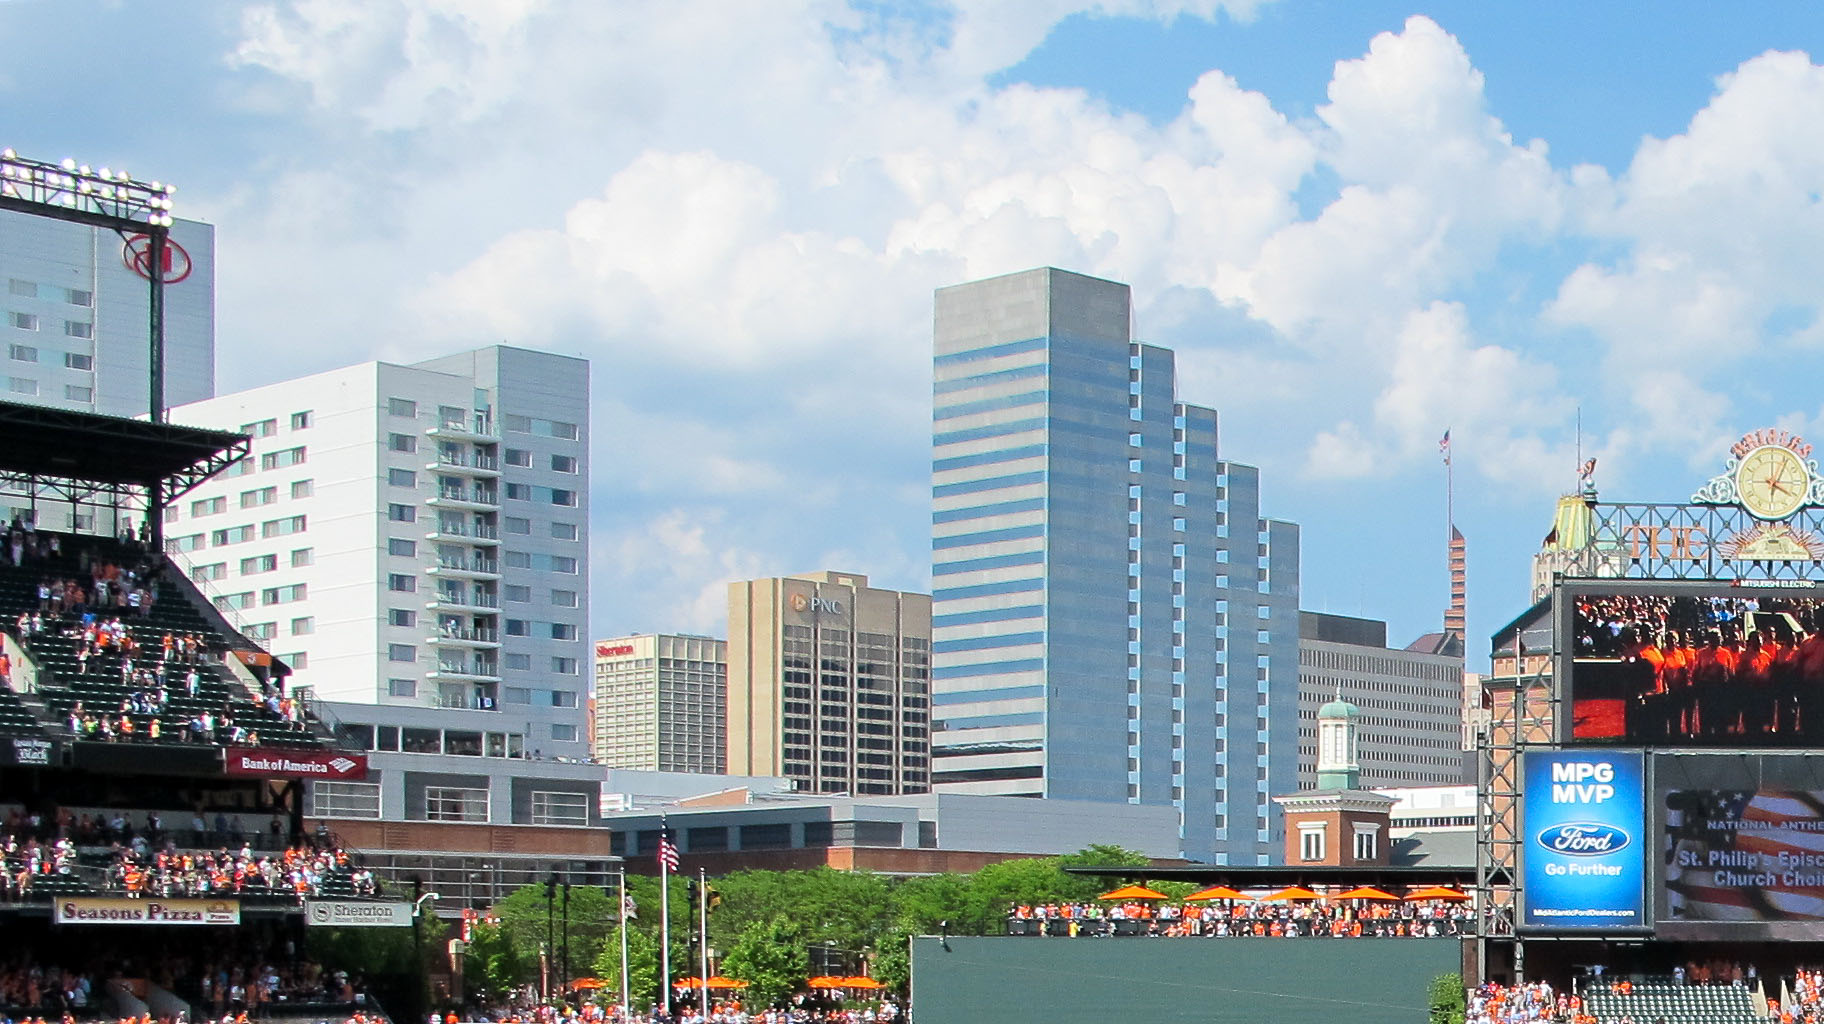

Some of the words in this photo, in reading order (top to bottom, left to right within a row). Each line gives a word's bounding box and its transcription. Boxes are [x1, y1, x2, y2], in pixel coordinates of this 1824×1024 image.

[1625, 525, 1707, 560] THE
[810, 597, 841, 615] PNC
[242, 757, 270, 770] Bank
[282, 759, 328, 774] America
[1552, 762, 1614, 783] MPG
[1552, 784, 1614, 804] MVP
[1706, 820, 1772, 831] NATIONAL
[1554, 825, 1613, 851] Ford
[1679, 851, 1703, 867] St.
[1708, 851, 1774, 870] Philip's
[1545, 863, 1566, 876] Go
[1568, 863, 1623, 876] Further
[1714, 870, 1777, 887] Church
[64, 903, 142, 920] Seasons
[148, 903, 202, 920] Pizza
[335, 904, 393, 916] Sheraton
